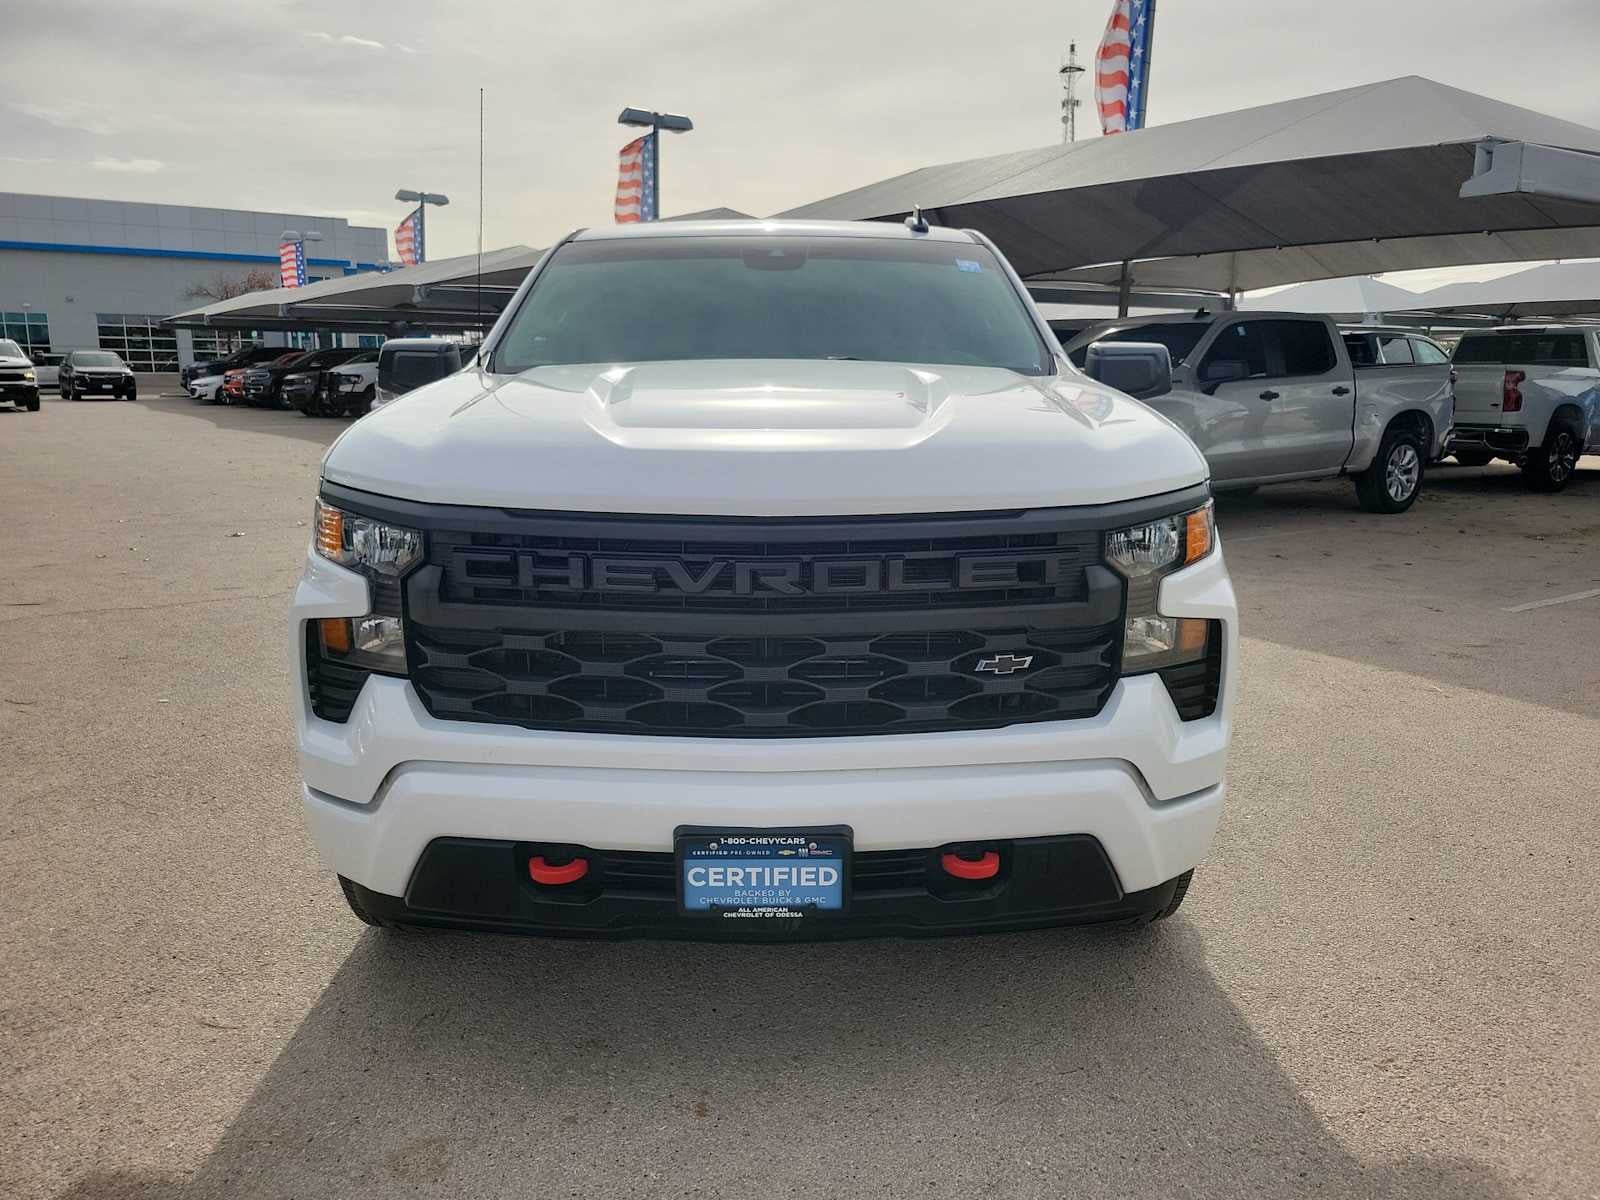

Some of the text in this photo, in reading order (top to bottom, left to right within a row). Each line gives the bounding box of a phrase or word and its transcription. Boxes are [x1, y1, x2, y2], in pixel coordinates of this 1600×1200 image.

[452, 548, 1078, 595] CHEVROLET
[720, 837, 806, 845] 1-800-CHEVYCARS
[687, 867, 839, 887] CERTIFIED
[734, 889, 791, 897] BACKED BY
[762, 896, 792, 905] BUICK
[794, 897, 801, 905] &
[804, 896, 826, 904] GMC
